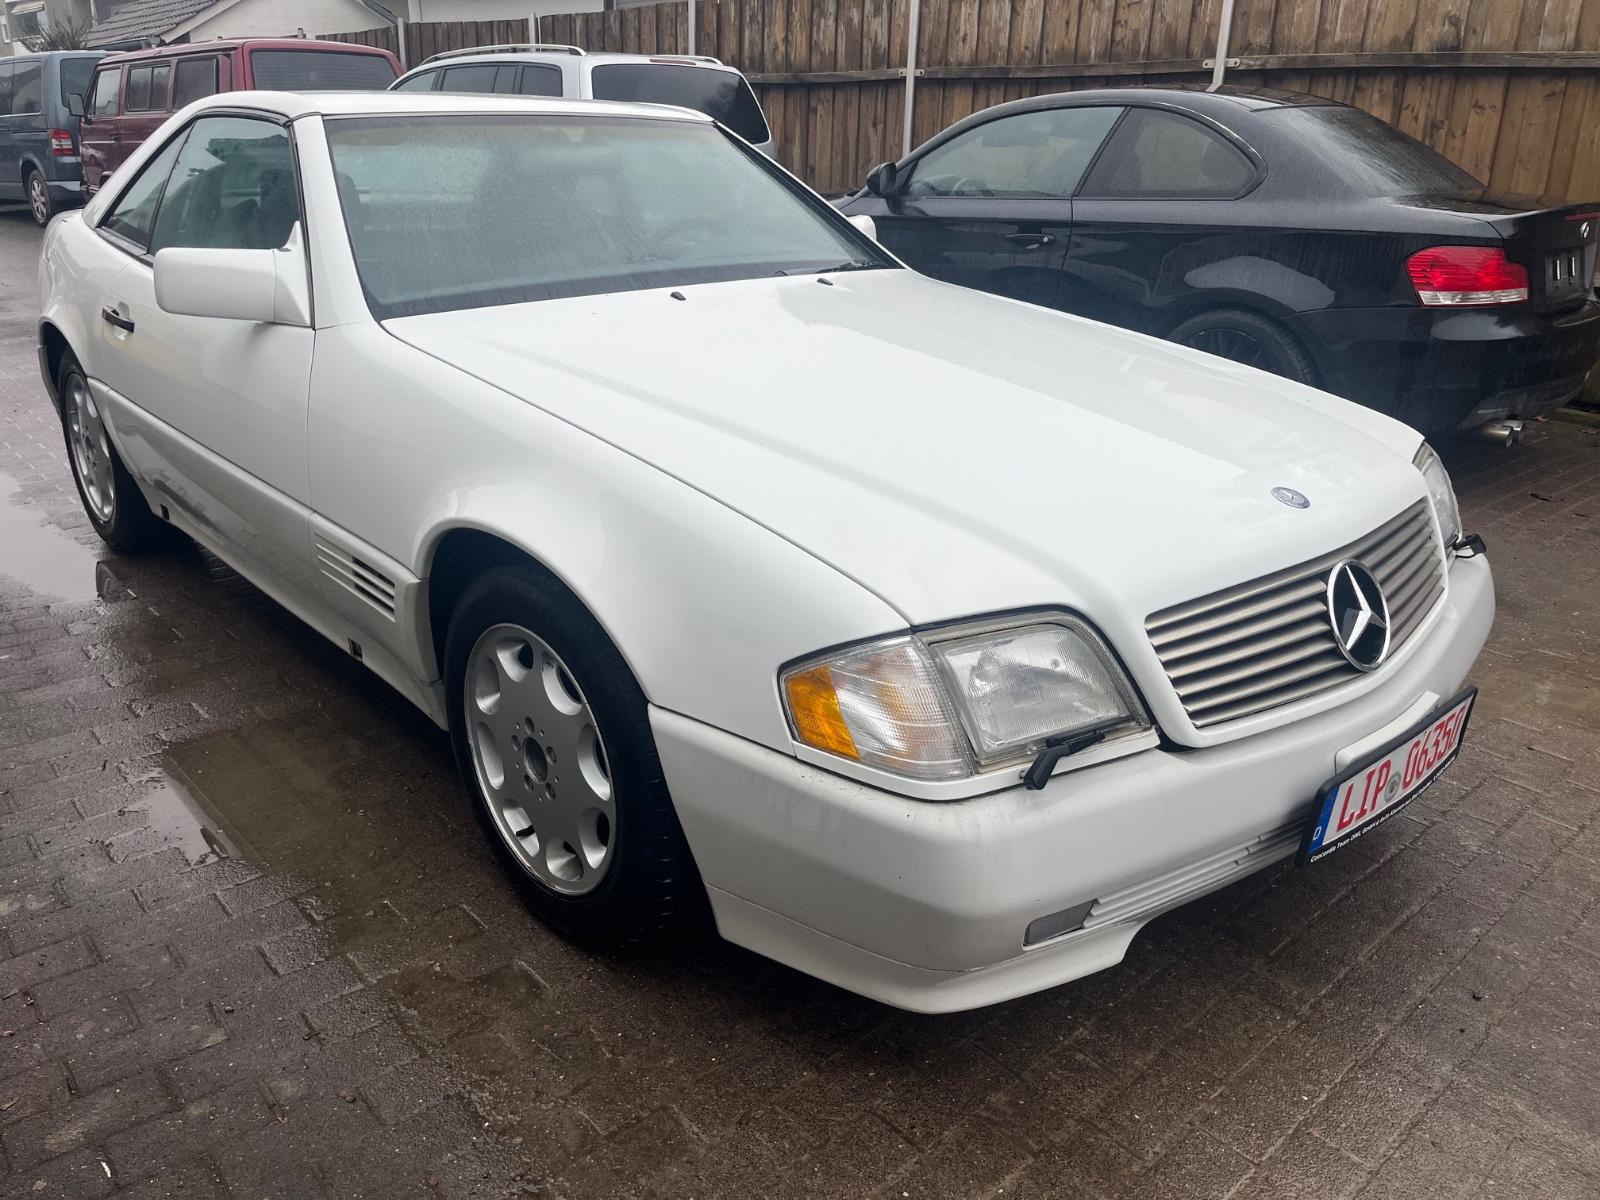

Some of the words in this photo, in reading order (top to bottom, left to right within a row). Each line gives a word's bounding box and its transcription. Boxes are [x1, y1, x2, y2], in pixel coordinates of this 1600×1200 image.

[1337, 759, 1392, 832] LIP
[1402, 704, 1466, 790] 06350
[1312, 826, 1322, 841] D
